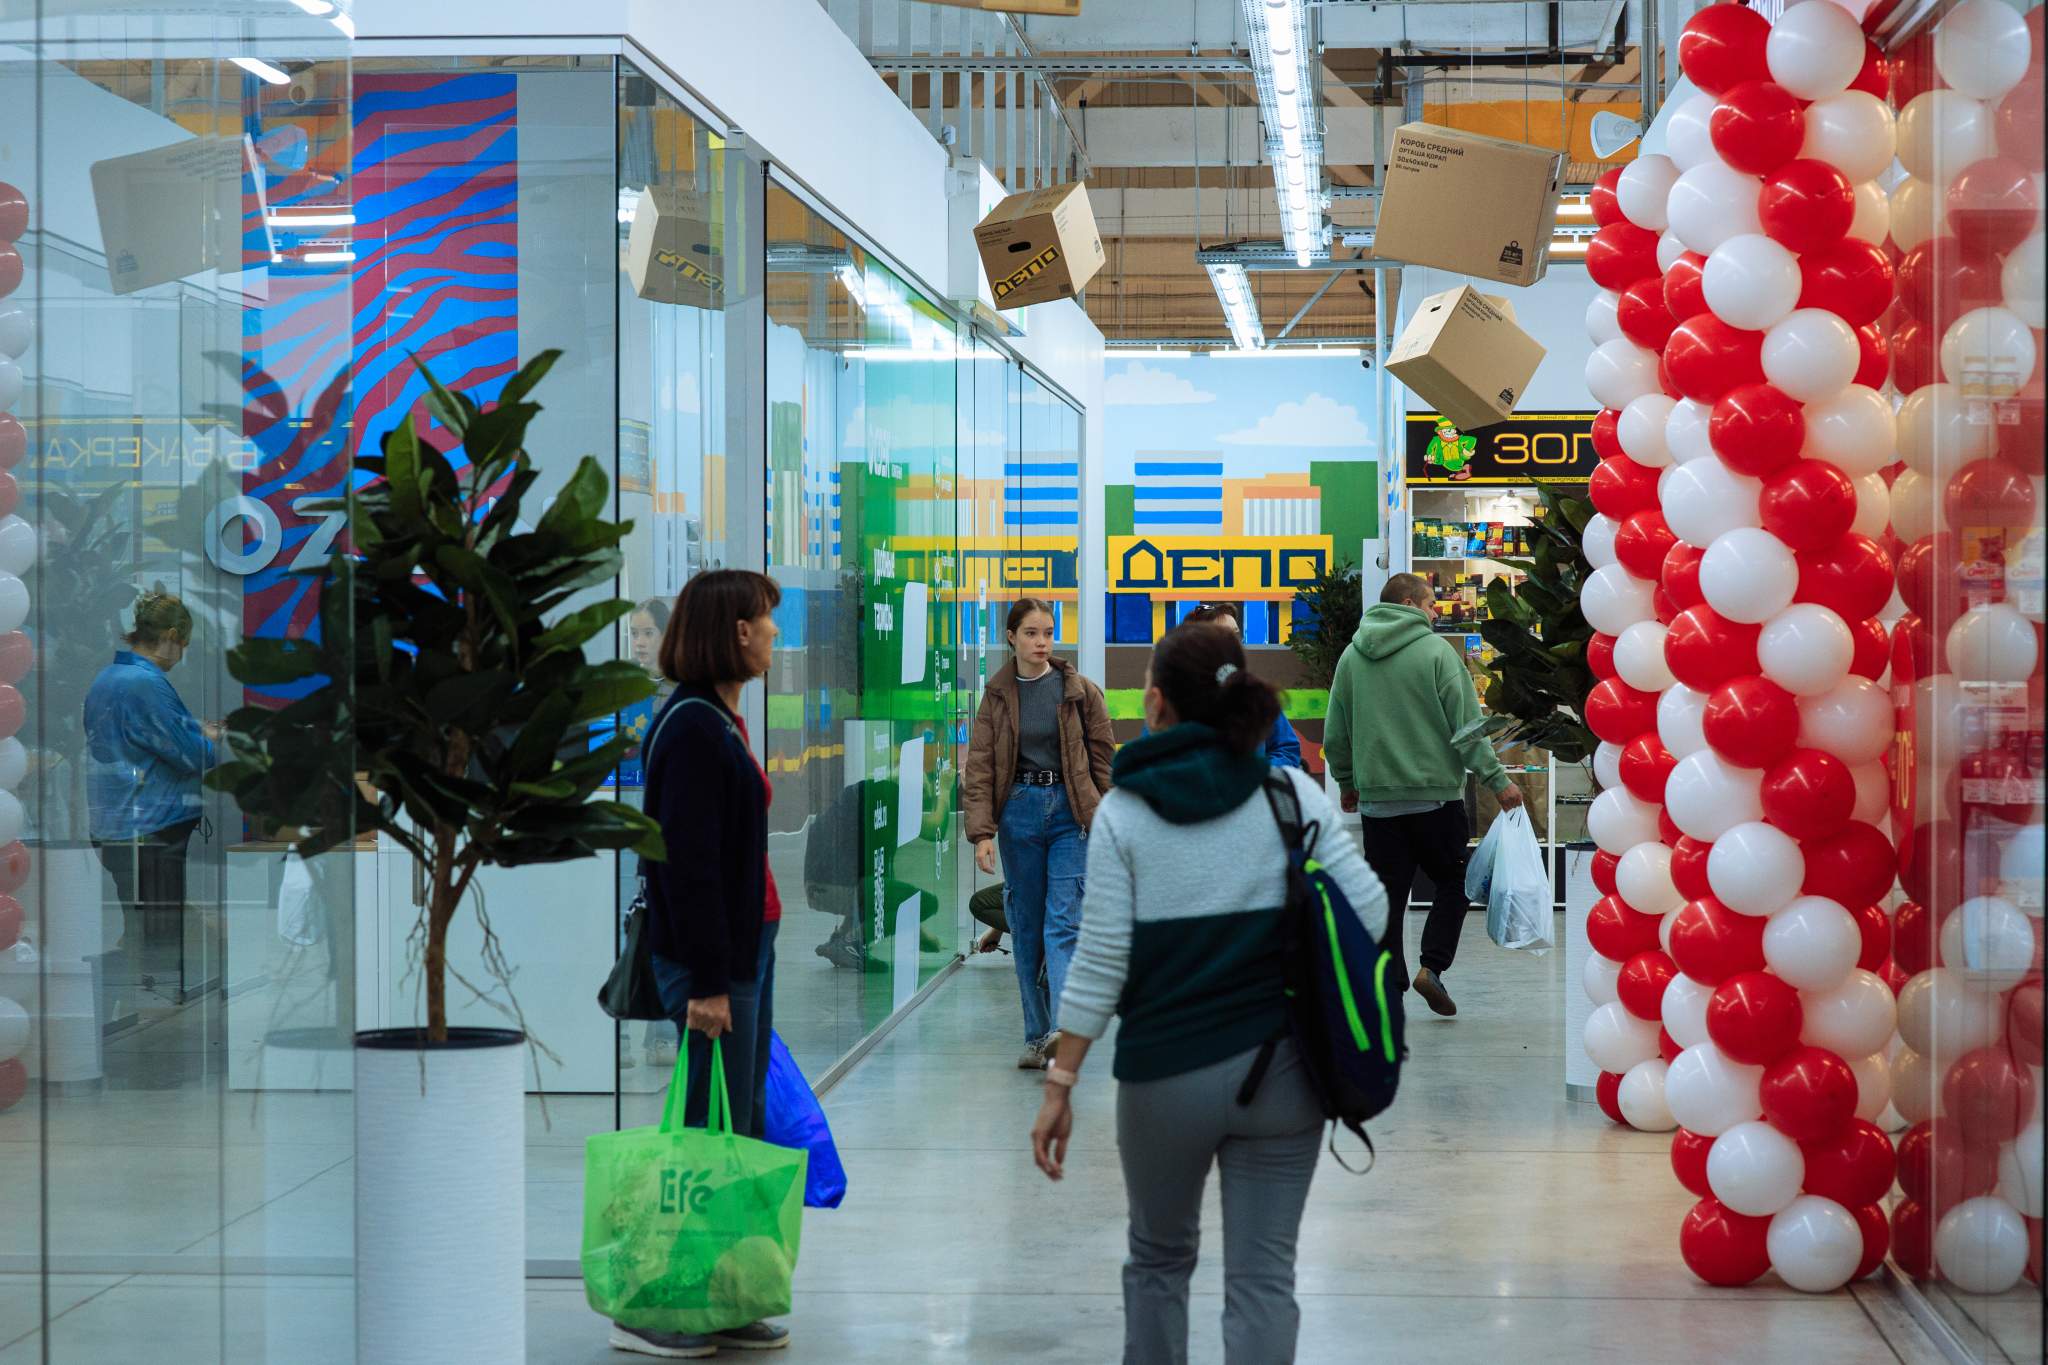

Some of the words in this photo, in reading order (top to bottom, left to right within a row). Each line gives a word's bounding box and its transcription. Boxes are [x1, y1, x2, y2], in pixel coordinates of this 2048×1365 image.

[1398, 147, 1426, 158] ОРТАША
[1400, 137, 1426, 149] КОРОБ
[1427, 143, 1465, 157] СРЕДНИЙ
[993, 245, 1059, 300] ДЕПО
[1115, 539, 1327, 589] ДЕПО
